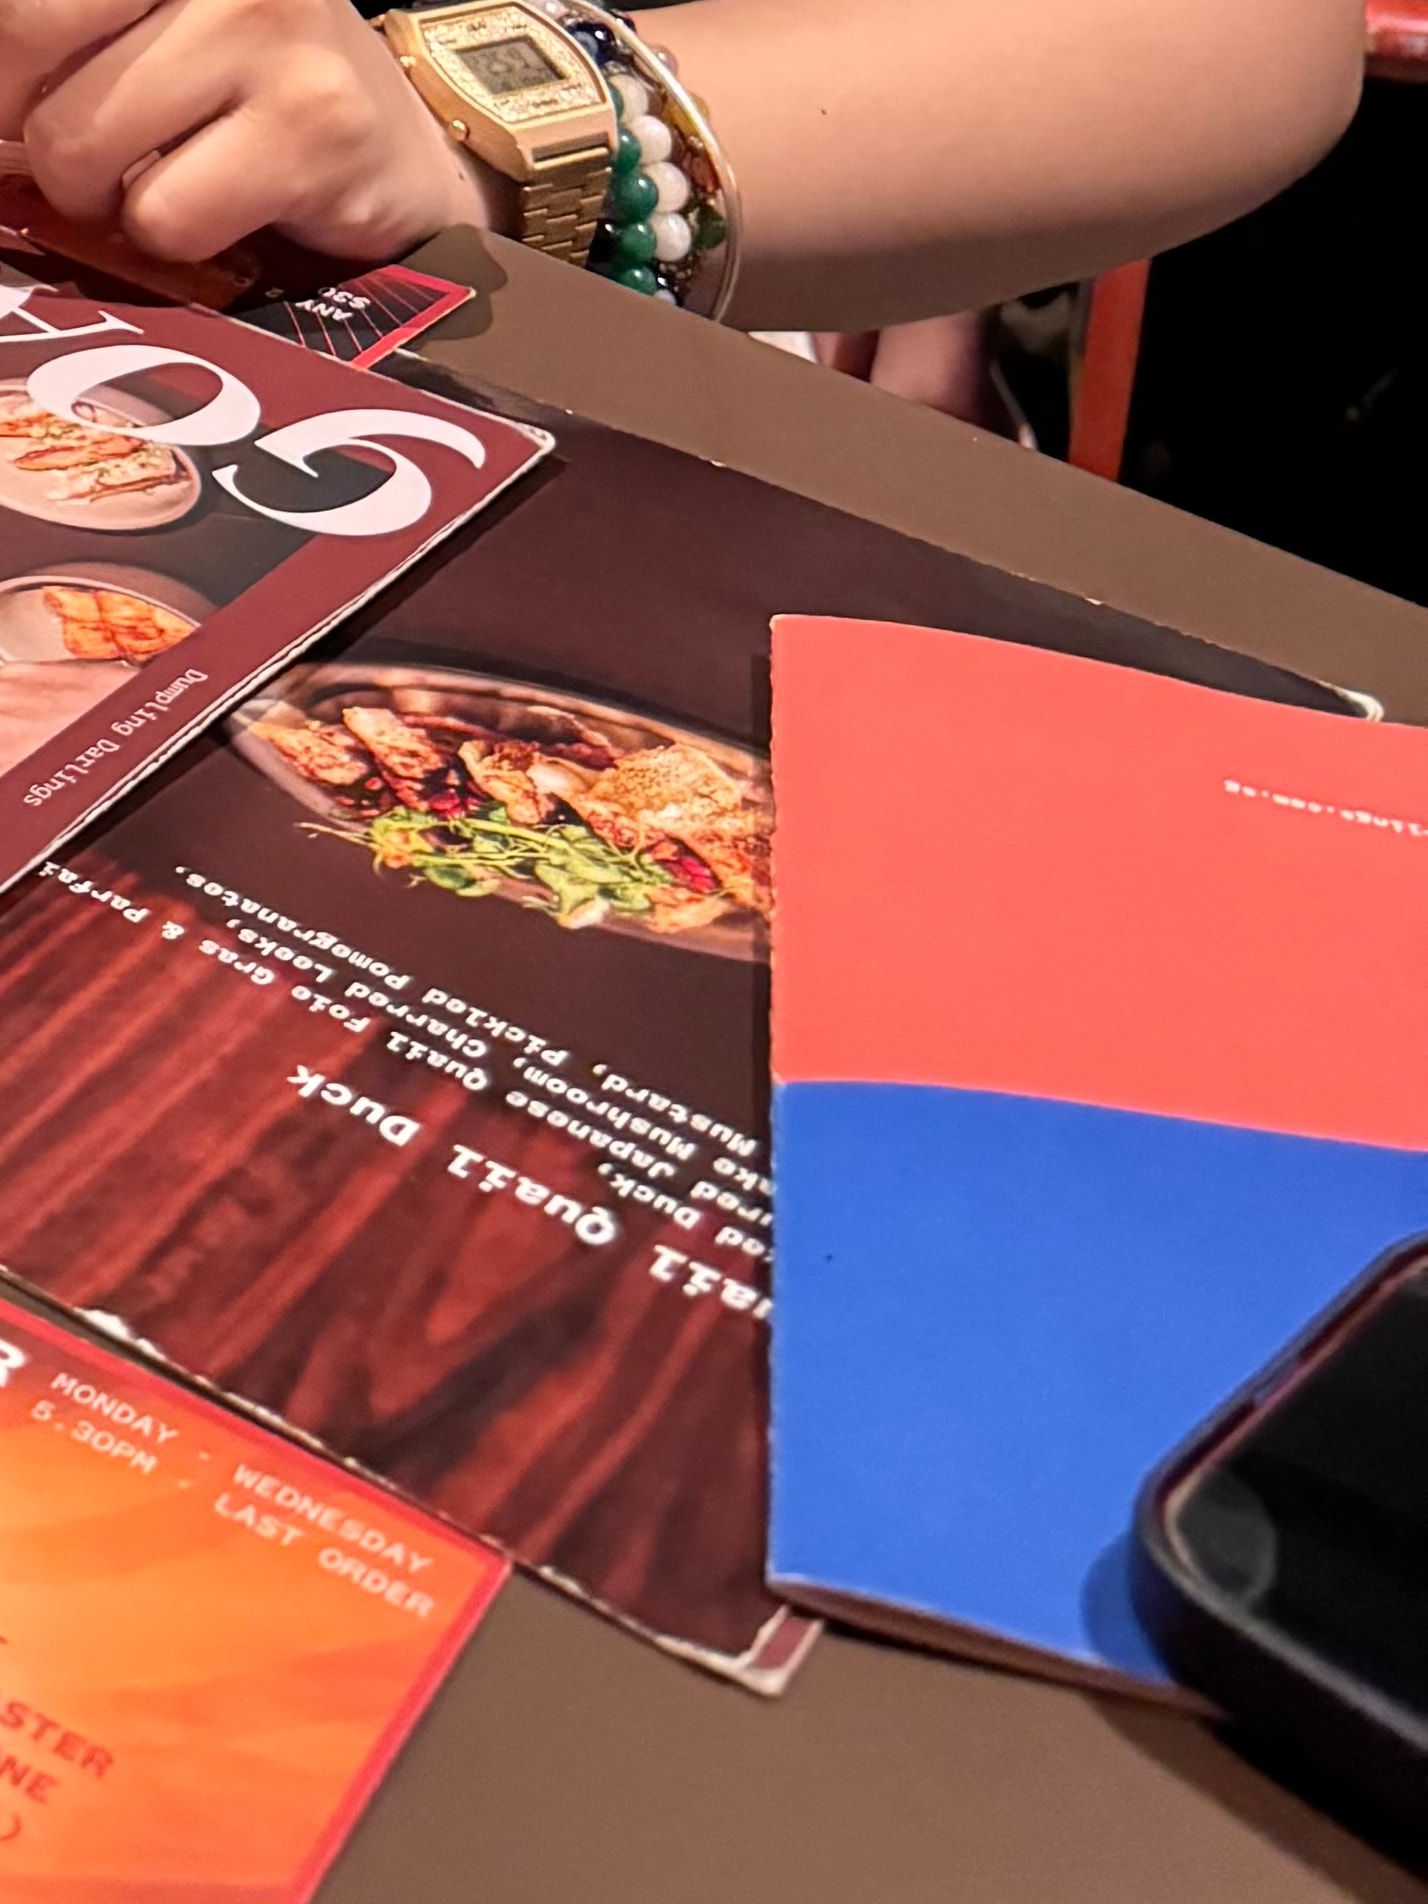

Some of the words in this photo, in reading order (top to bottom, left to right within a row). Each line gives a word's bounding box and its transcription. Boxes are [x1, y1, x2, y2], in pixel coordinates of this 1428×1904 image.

[294, 299, 354, 321] ANY
[110, 668, 209, 737] Dumpling
[23, 738, 121, 807] Darlings
[38, 860, 150, 924] Parfai
[175, 866, 412, 991] Pomegranates.
[198, 939, 276, 986] Gras
[291, 985, 372, 1033] Foie
[421, 988, 569, 1067] Pickled
[386, 1031, 489, 1091] Quail
[286, 1064, 421, 1147] Duck
[505, 1090, 676, 1178] Japanese
[592, 1063, 757, 1157] Mustard,
[447, 1144, 617, 1245] Quail
[597, 1163, 703, 1230] Duck,
[31, 1399, 159, 1474] 5.30PM
[214, 1493, 304, 1545] LAST
[319, 1547, 436, 1618] ORDER
[50, 1372, 178, 1443] MONDAY
[233, 1464, 433, 1573] WEDNESDAY
